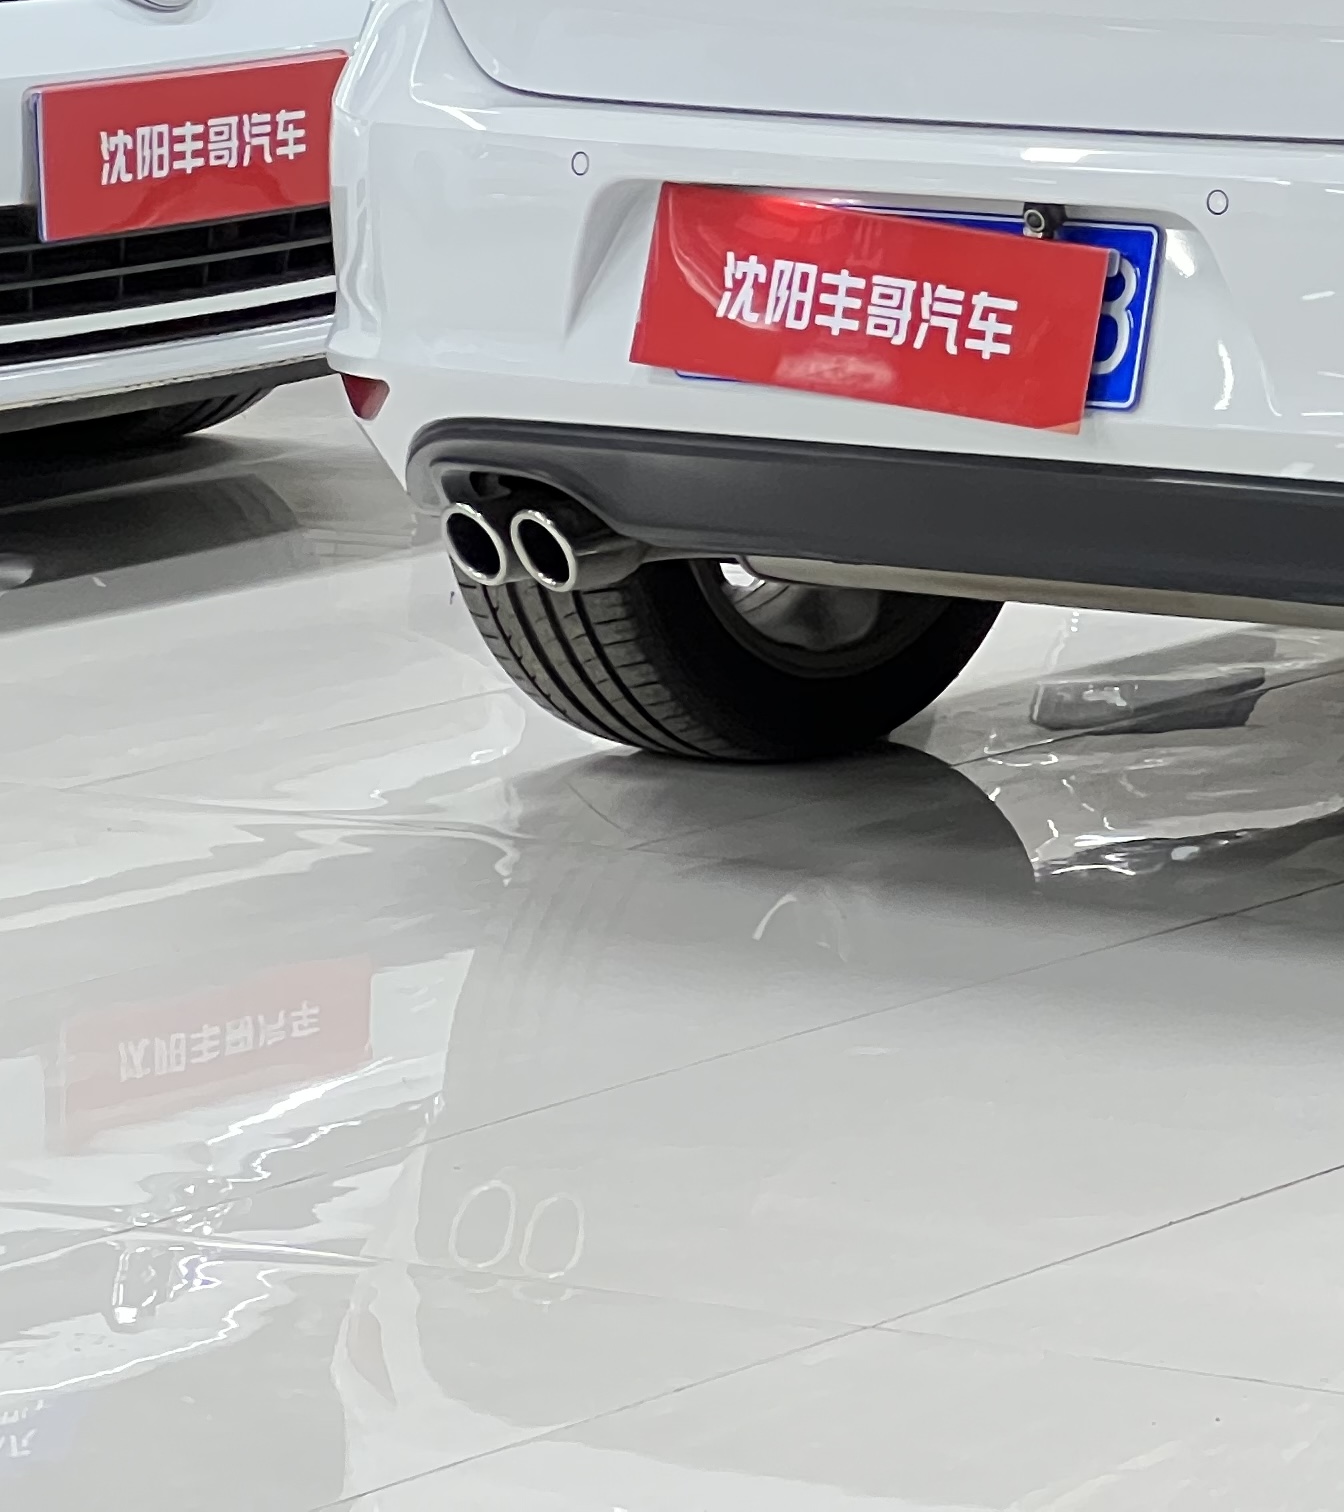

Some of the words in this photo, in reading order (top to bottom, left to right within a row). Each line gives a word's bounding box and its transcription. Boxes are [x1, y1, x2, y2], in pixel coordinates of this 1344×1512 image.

[100, 109, 307, 186] 沈阳丰哥汽车
[716, 251, 1018, 360] 沈阳丰哥汽车
